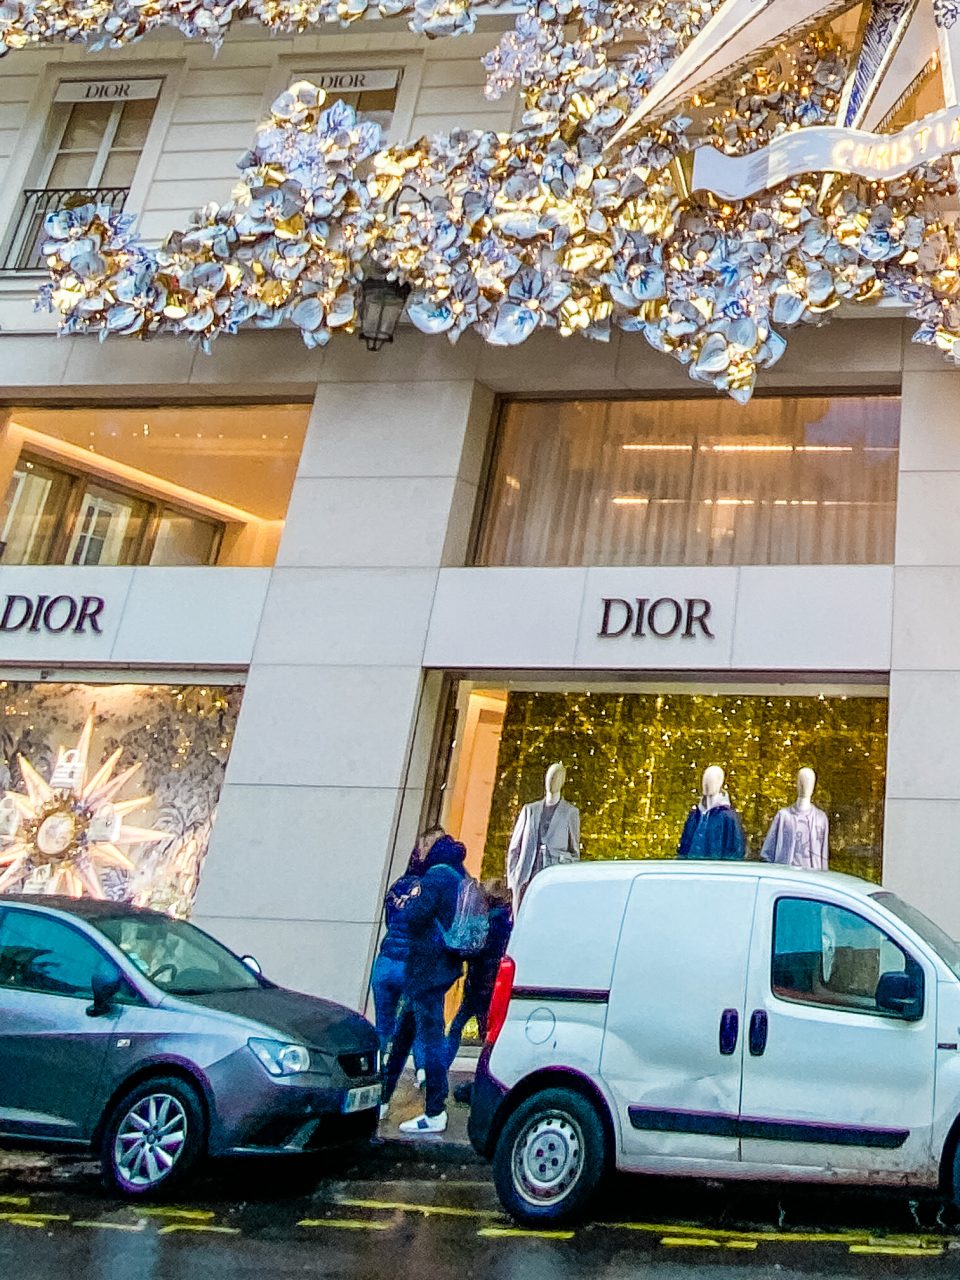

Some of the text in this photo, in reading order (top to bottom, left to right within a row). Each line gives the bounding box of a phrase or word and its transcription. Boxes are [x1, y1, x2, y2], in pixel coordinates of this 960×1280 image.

[84, 83, 131, 98] DIOR
[320, 73, 365, 88] DIOR
[0, 594, 105, 634] DIOR
[597, 597, 715, 639] DIOR
